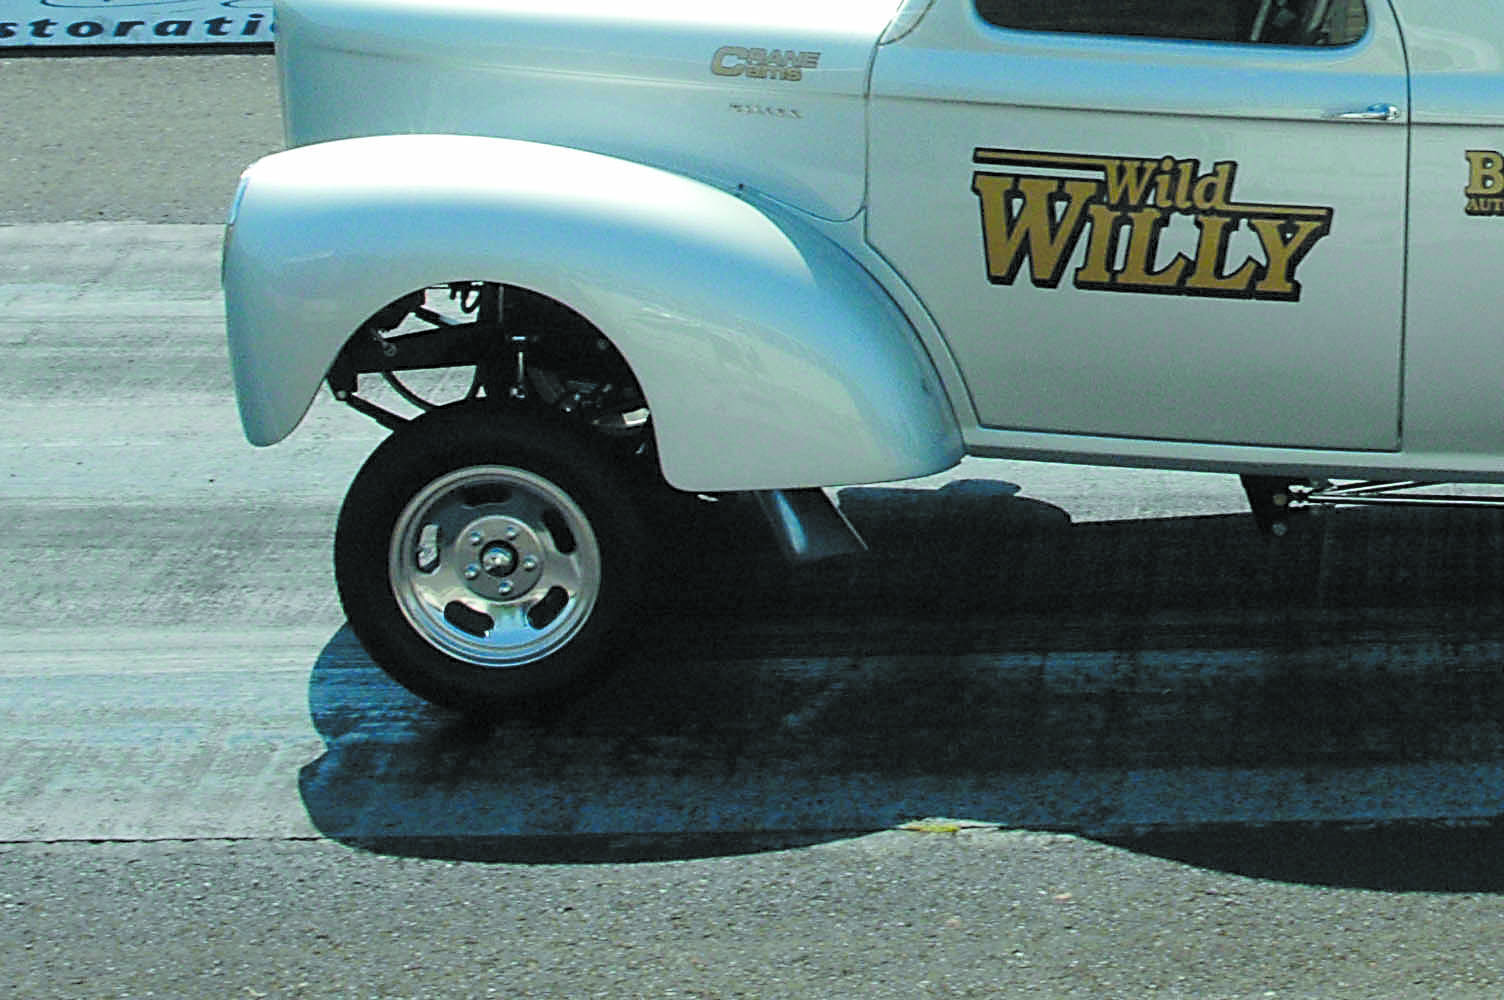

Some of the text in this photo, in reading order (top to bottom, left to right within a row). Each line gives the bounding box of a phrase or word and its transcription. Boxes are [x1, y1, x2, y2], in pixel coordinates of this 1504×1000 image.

[0, 12, 274, 39] storati
[1102, 155, 1238, 212] Wild
[971, 170, 1331, 302] WILLY
